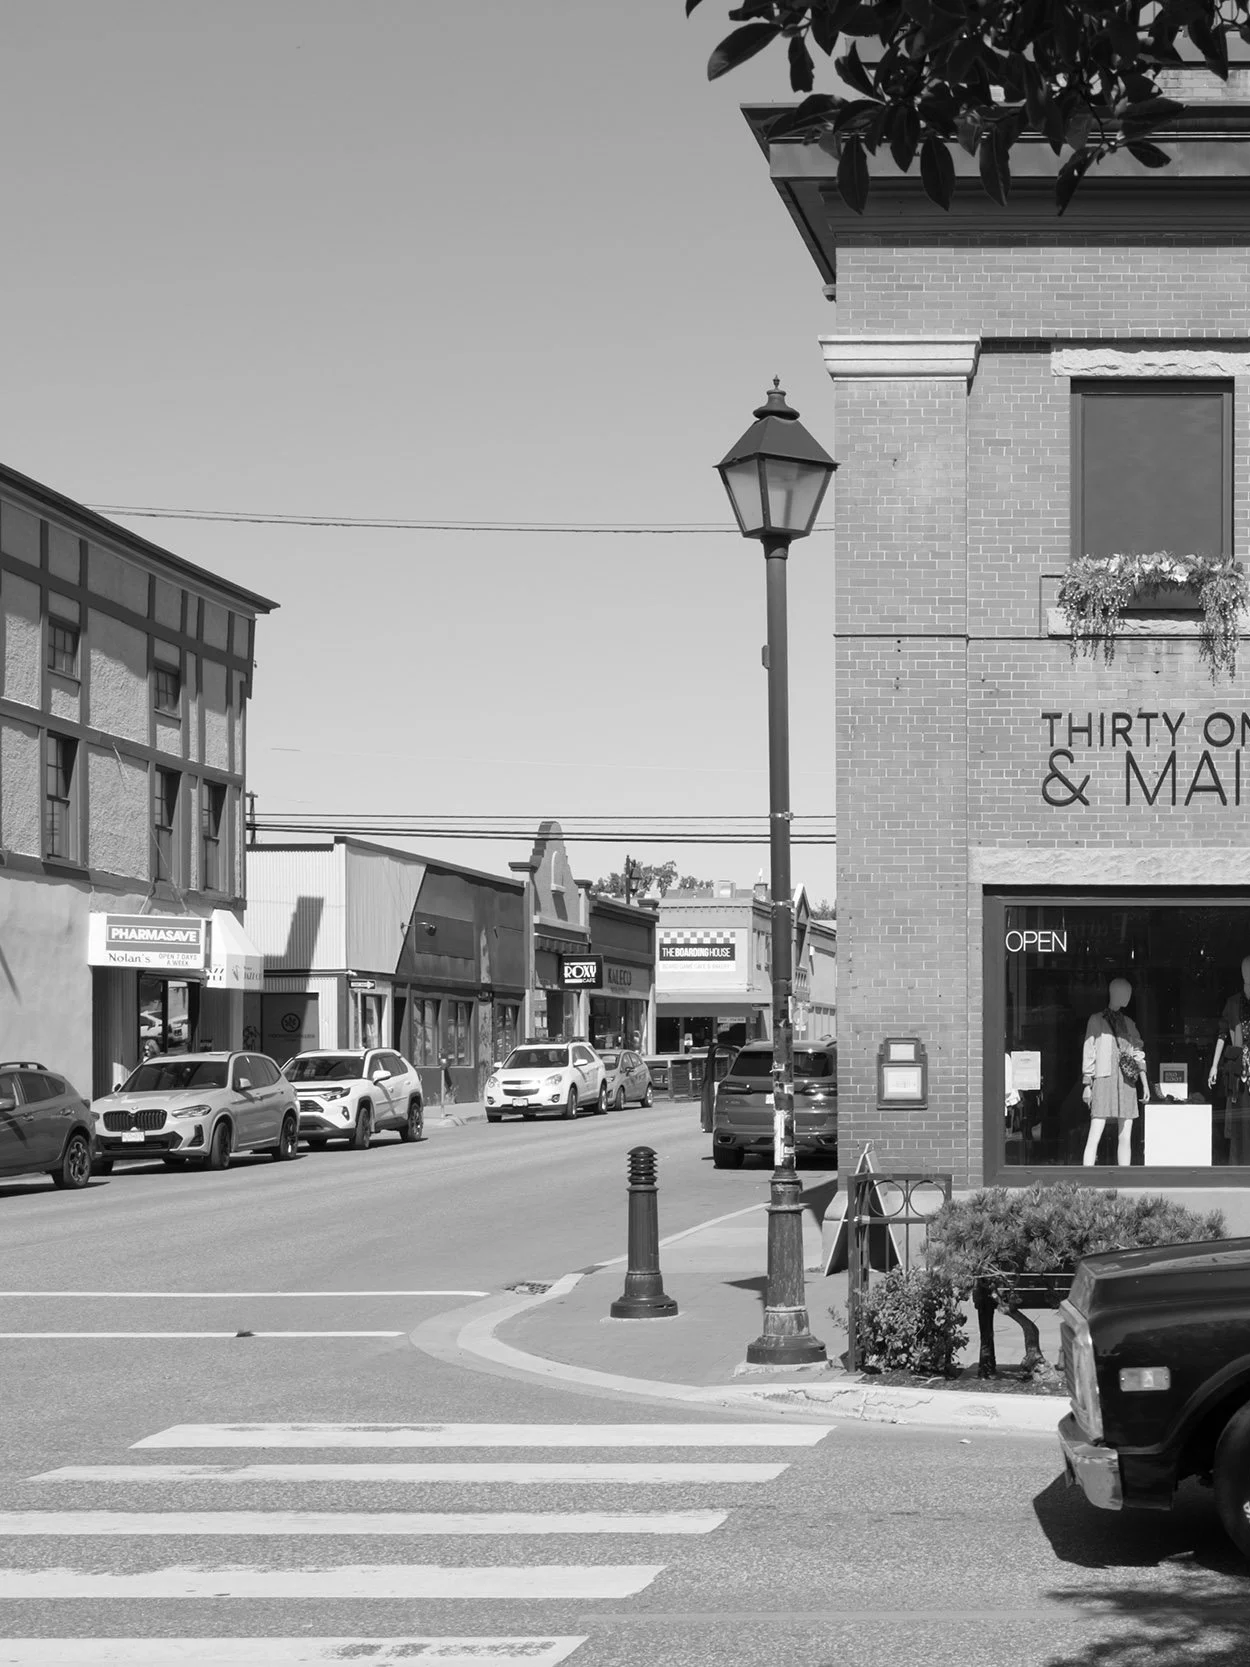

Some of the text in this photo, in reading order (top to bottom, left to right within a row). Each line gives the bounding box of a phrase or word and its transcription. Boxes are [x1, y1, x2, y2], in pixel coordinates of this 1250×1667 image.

[1041, 711, 1186, 748] THIRTY
[1041, 748, 1090, 807] &
[111, 928, 197, 943] PHARMASAVE
[1005, 930, 1068, 953] OPEN
[109, 952, 151, 964] Nolan's
[662, 947, 731, 957] THE BOARDING HOUSE
[563, 965, 597, 978] ROXY
